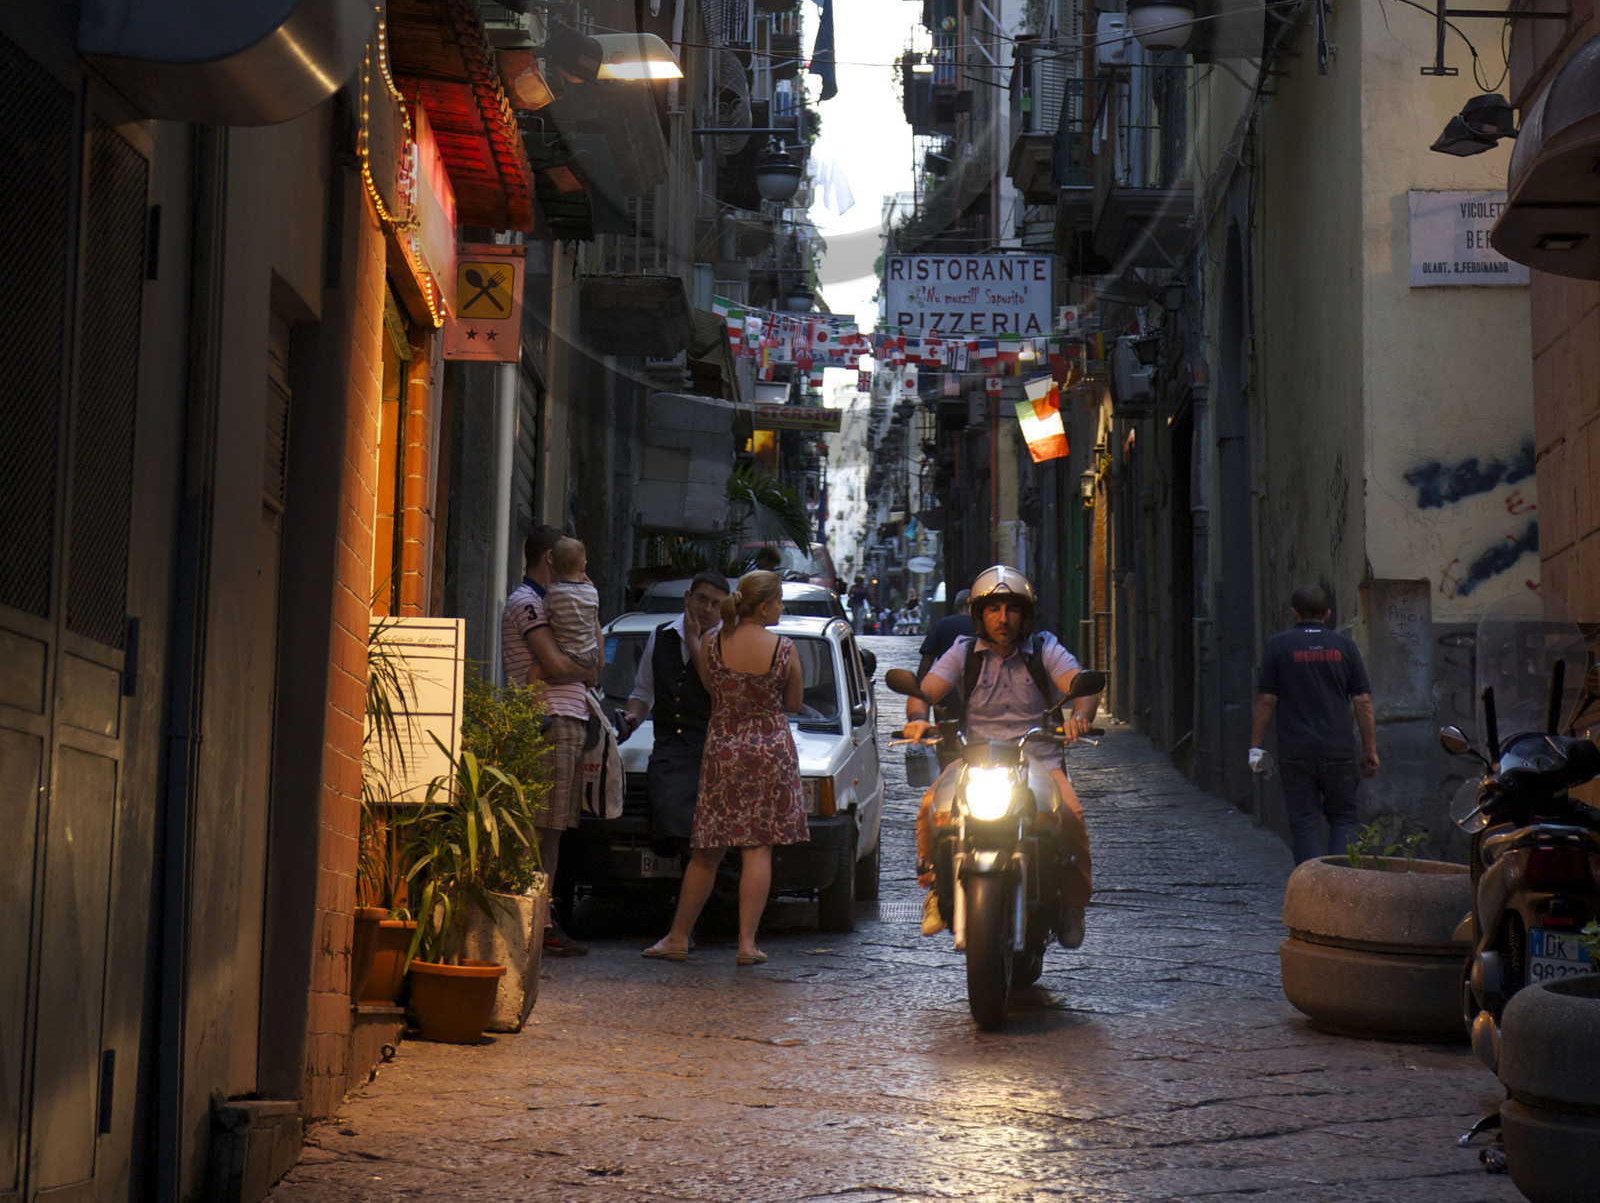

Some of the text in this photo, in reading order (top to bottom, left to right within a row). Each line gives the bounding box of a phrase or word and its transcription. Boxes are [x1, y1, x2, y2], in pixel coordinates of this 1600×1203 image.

[890, 259, 1046, 281] RISTORANTE
[897, 312, 1042, 334] PIZZERIA
[755, 405, 839, 422] ETERSIVI
[524, 604, 538, 621] 3
